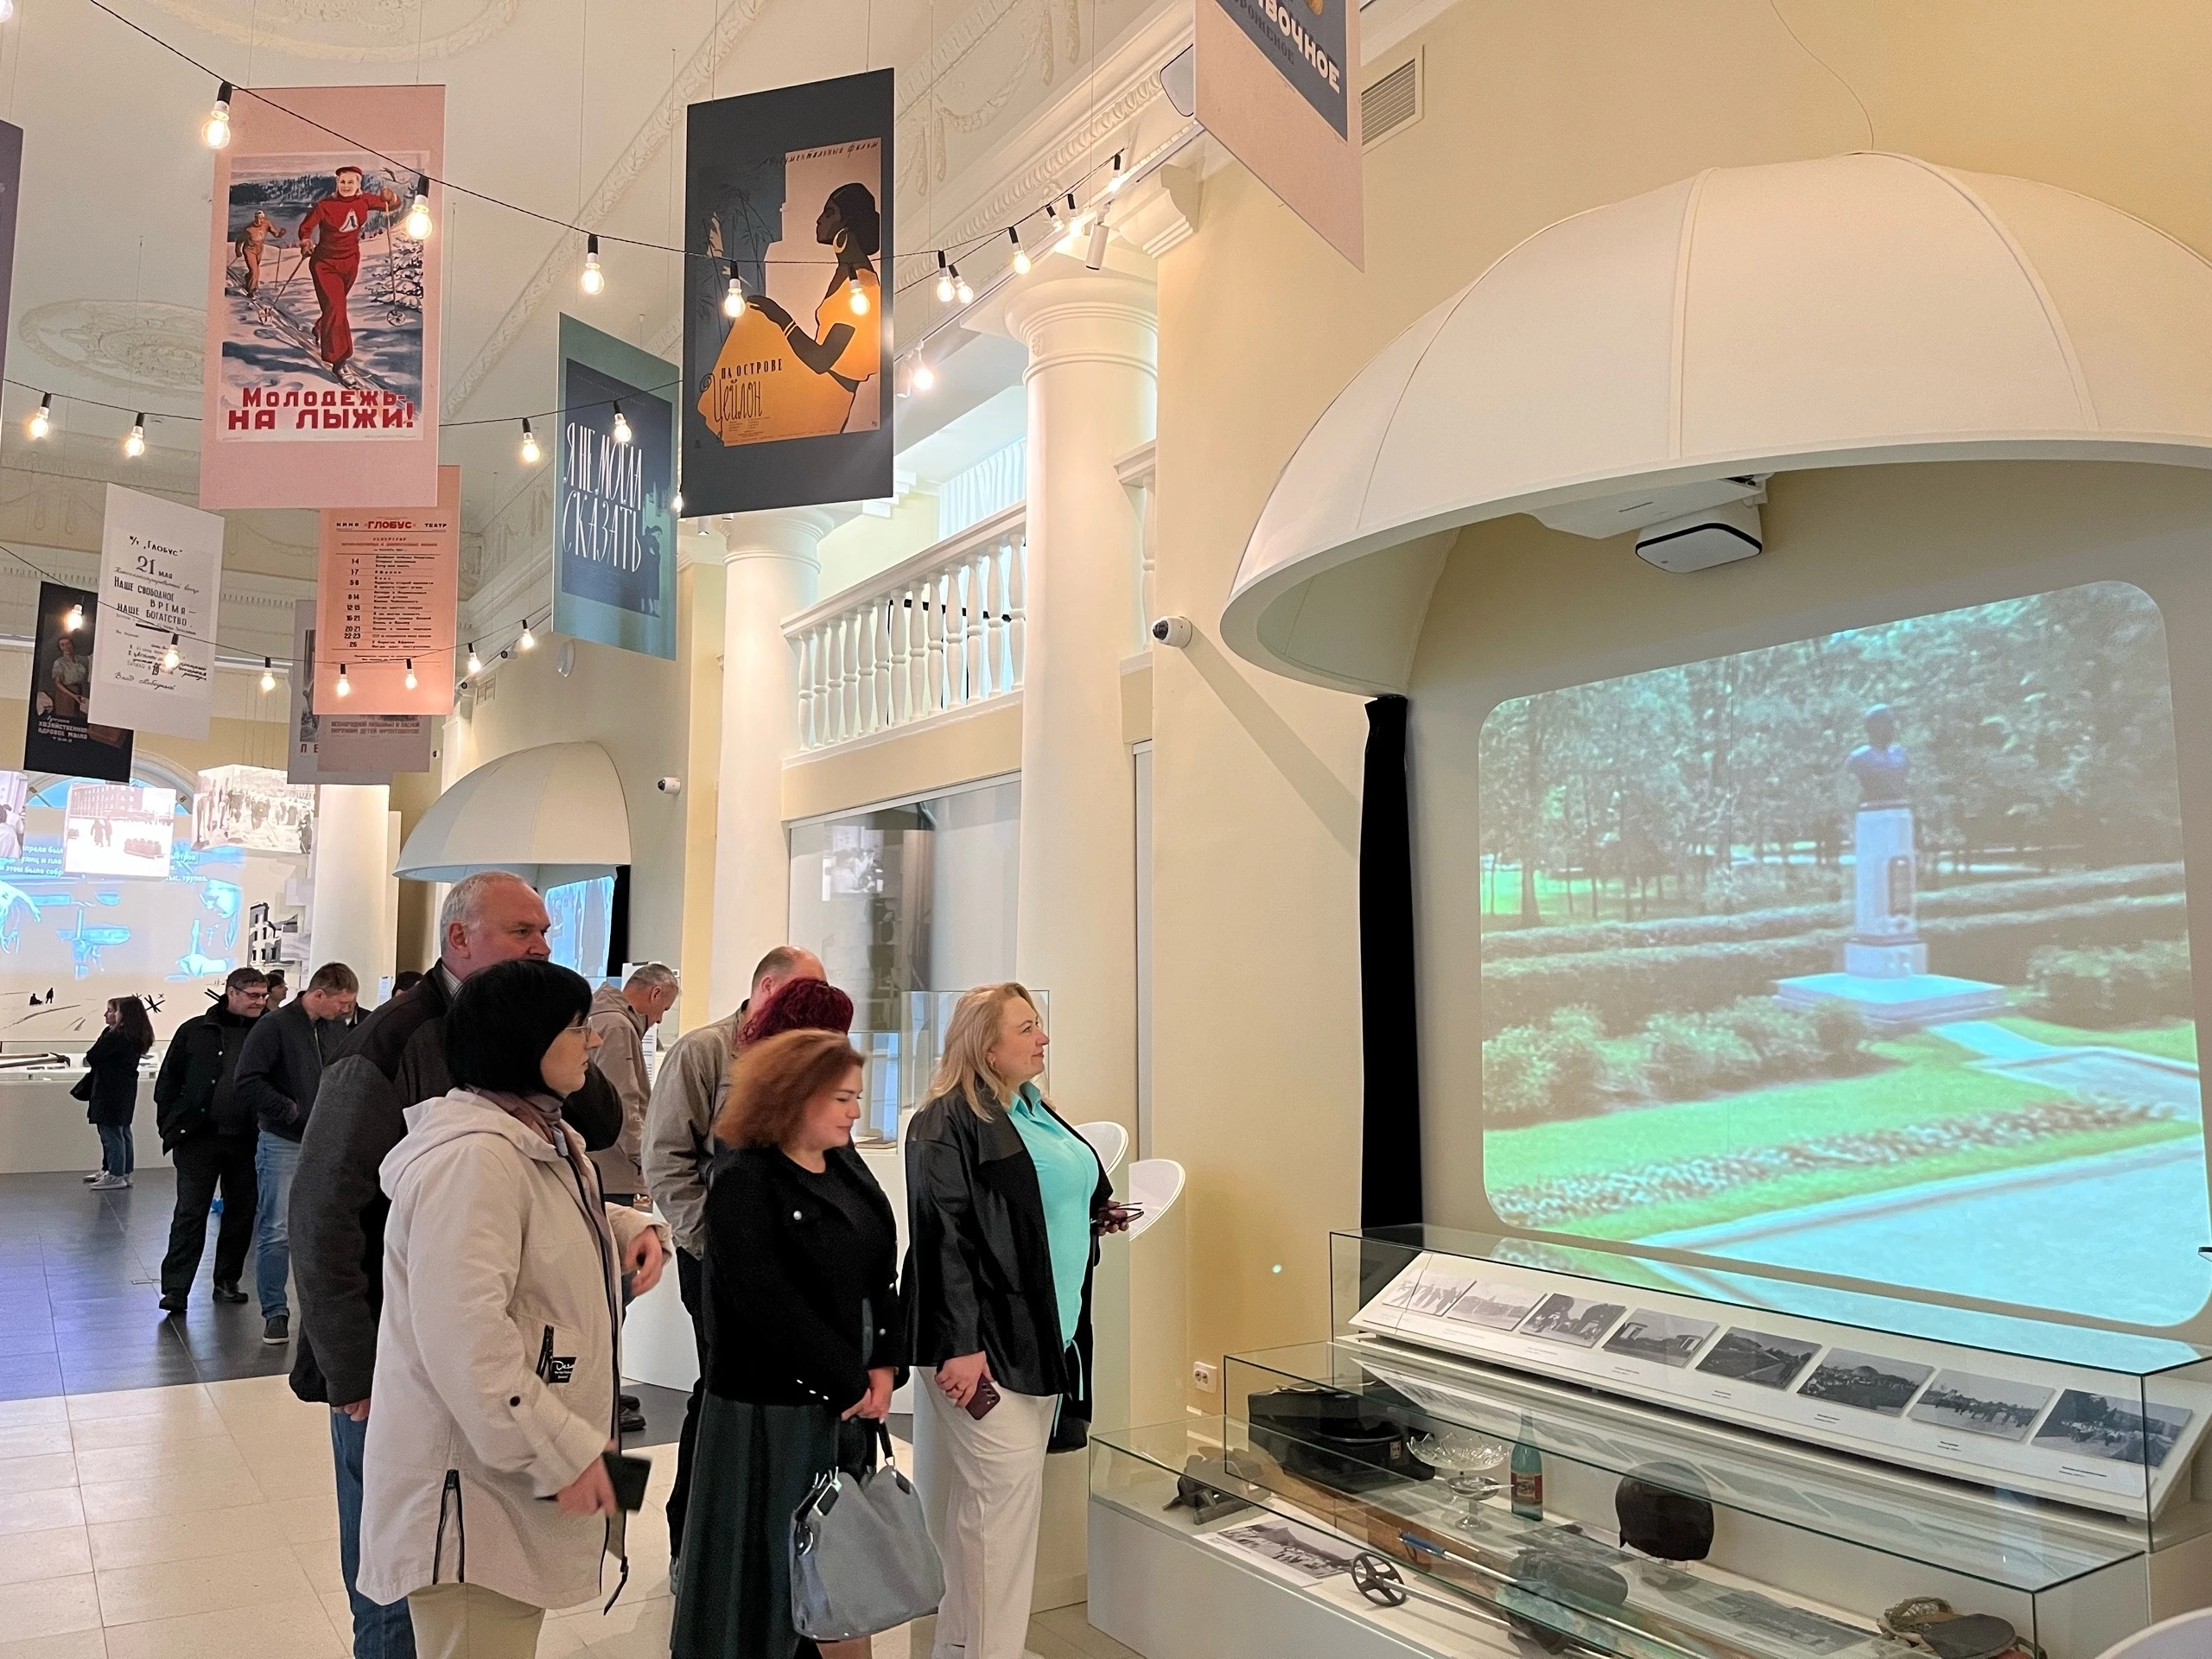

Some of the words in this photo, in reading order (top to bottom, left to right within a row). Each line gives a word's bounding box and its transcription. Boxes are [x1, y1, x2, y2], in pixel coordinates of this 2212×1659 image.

[736, 359, 782, 377] ОСТРОВЕ
[228, 410, 275, 430] НА
[296, 403, 414, 429] ЛЫЖИ!
[563, 422, 575, 486] Я
[579, 425, 594, 493] НЕ
[594, 434, 642, 511] МОГЛА
[563, 490, 642, 573] СКАЗАТЬ
[136, 556, 156, 575] 21
[137, 585, 175, 602] СВОБОДНОЕ
[117, 602, 140, 616] НАШЕ
